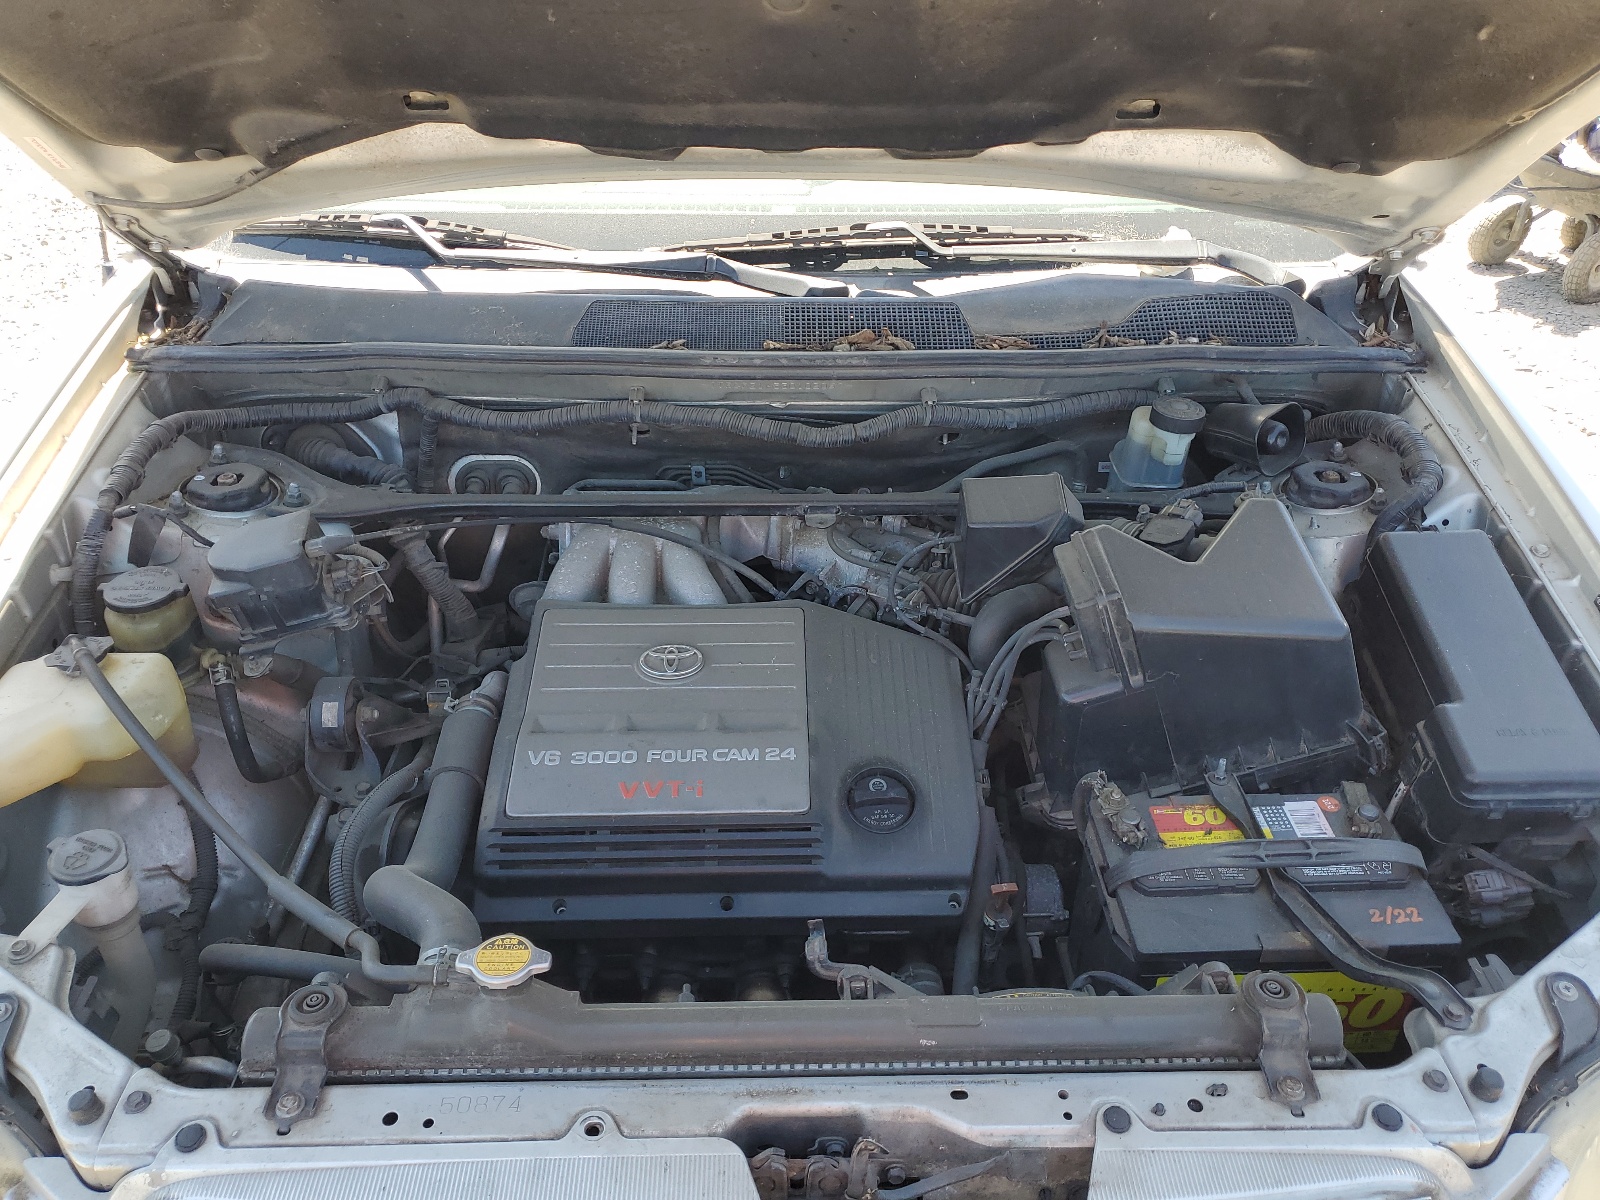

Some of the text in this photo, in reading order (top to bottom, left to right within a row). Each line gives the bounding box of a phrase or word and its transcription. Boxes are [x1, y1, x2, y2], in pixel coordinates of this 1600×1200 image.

[527, 747, 797, 766] V6 3000 FOUR CAM 24
[618, 780, 705, 800] VVT-i
[1183, 807, 1227, 826] 60
[1368, 905, 1424, 925] 2/22
[439, 1095, 522, 1115] 50874
